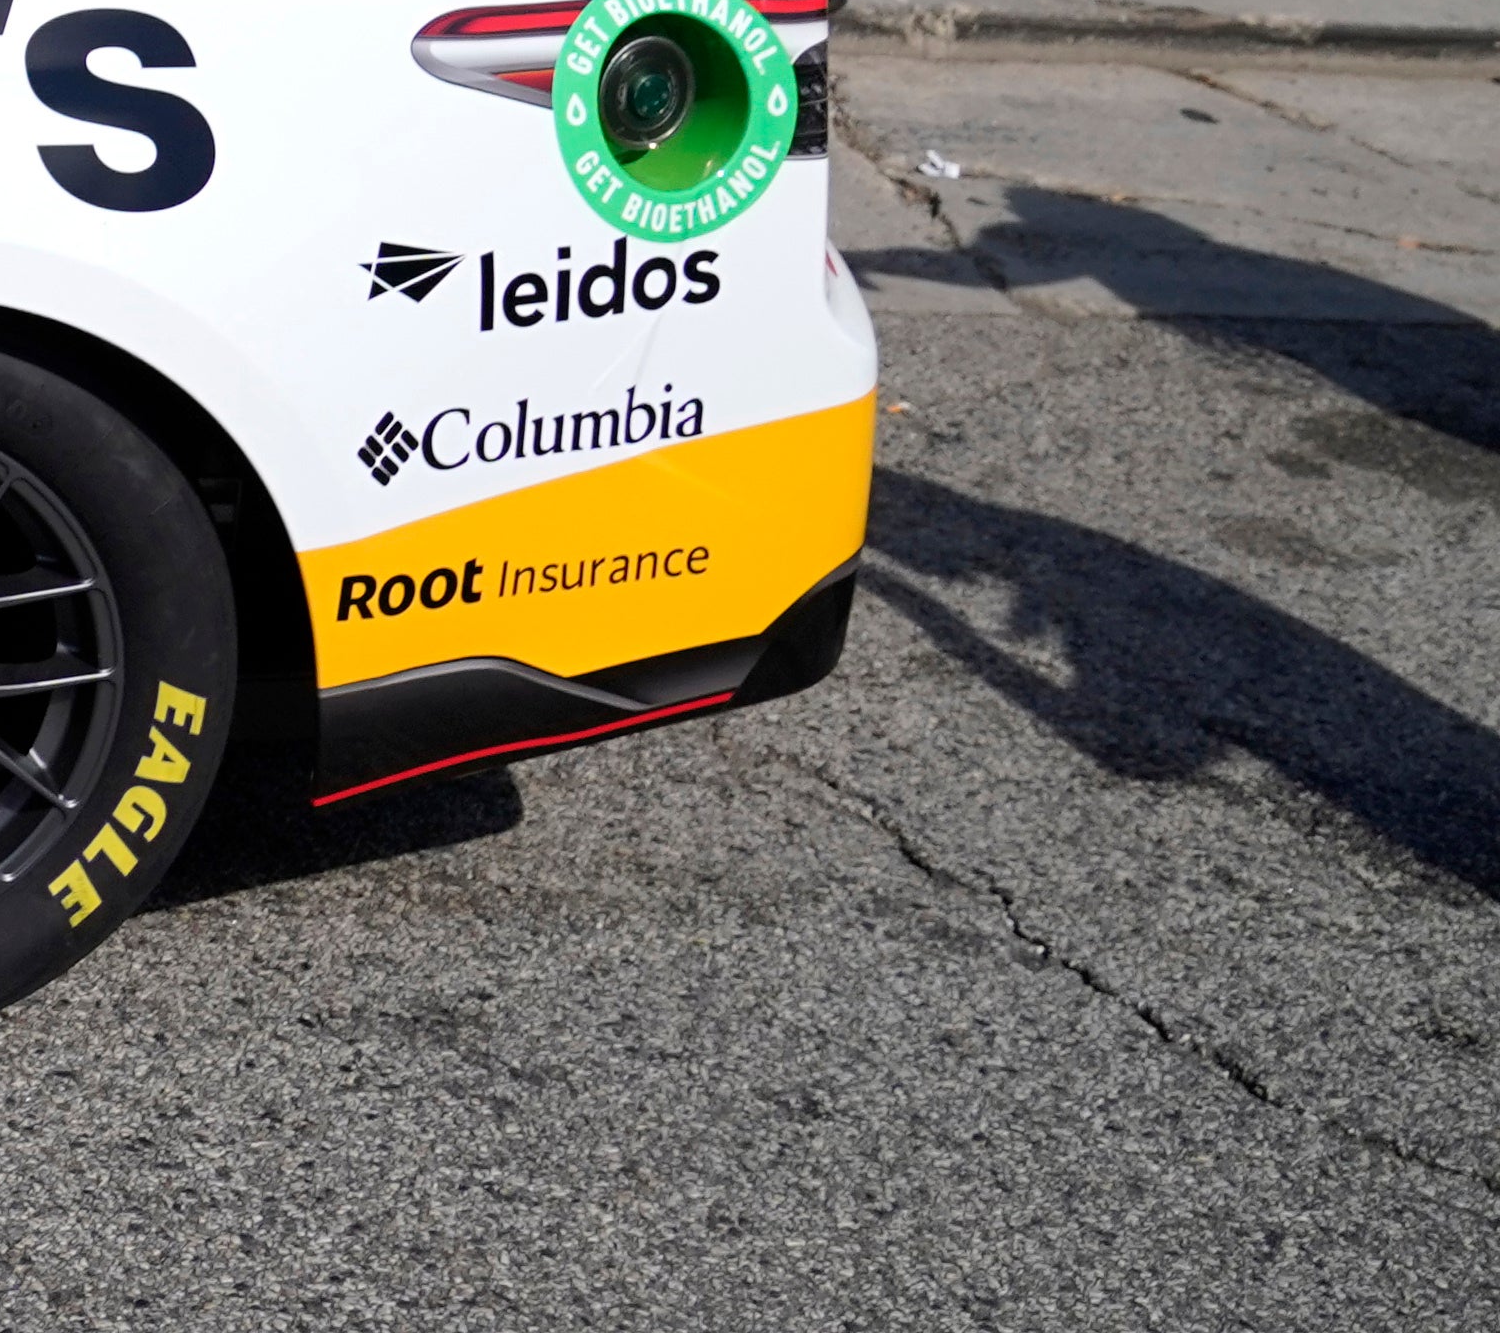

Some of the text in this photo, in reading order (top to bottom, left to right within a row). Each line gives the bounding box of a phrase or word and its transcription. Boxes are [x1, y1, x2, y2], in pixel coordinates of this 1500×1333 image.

[566, 16, 610, 76] GET
[575, 140, 781, 233] GET BIOETHANOL
[479, 235, 721, 331] leidos
[420, 383, 704, 471] Columbia
[335, 542, 711, 622] Root Insurance
[48, 679, 208, 929] EAGLE
